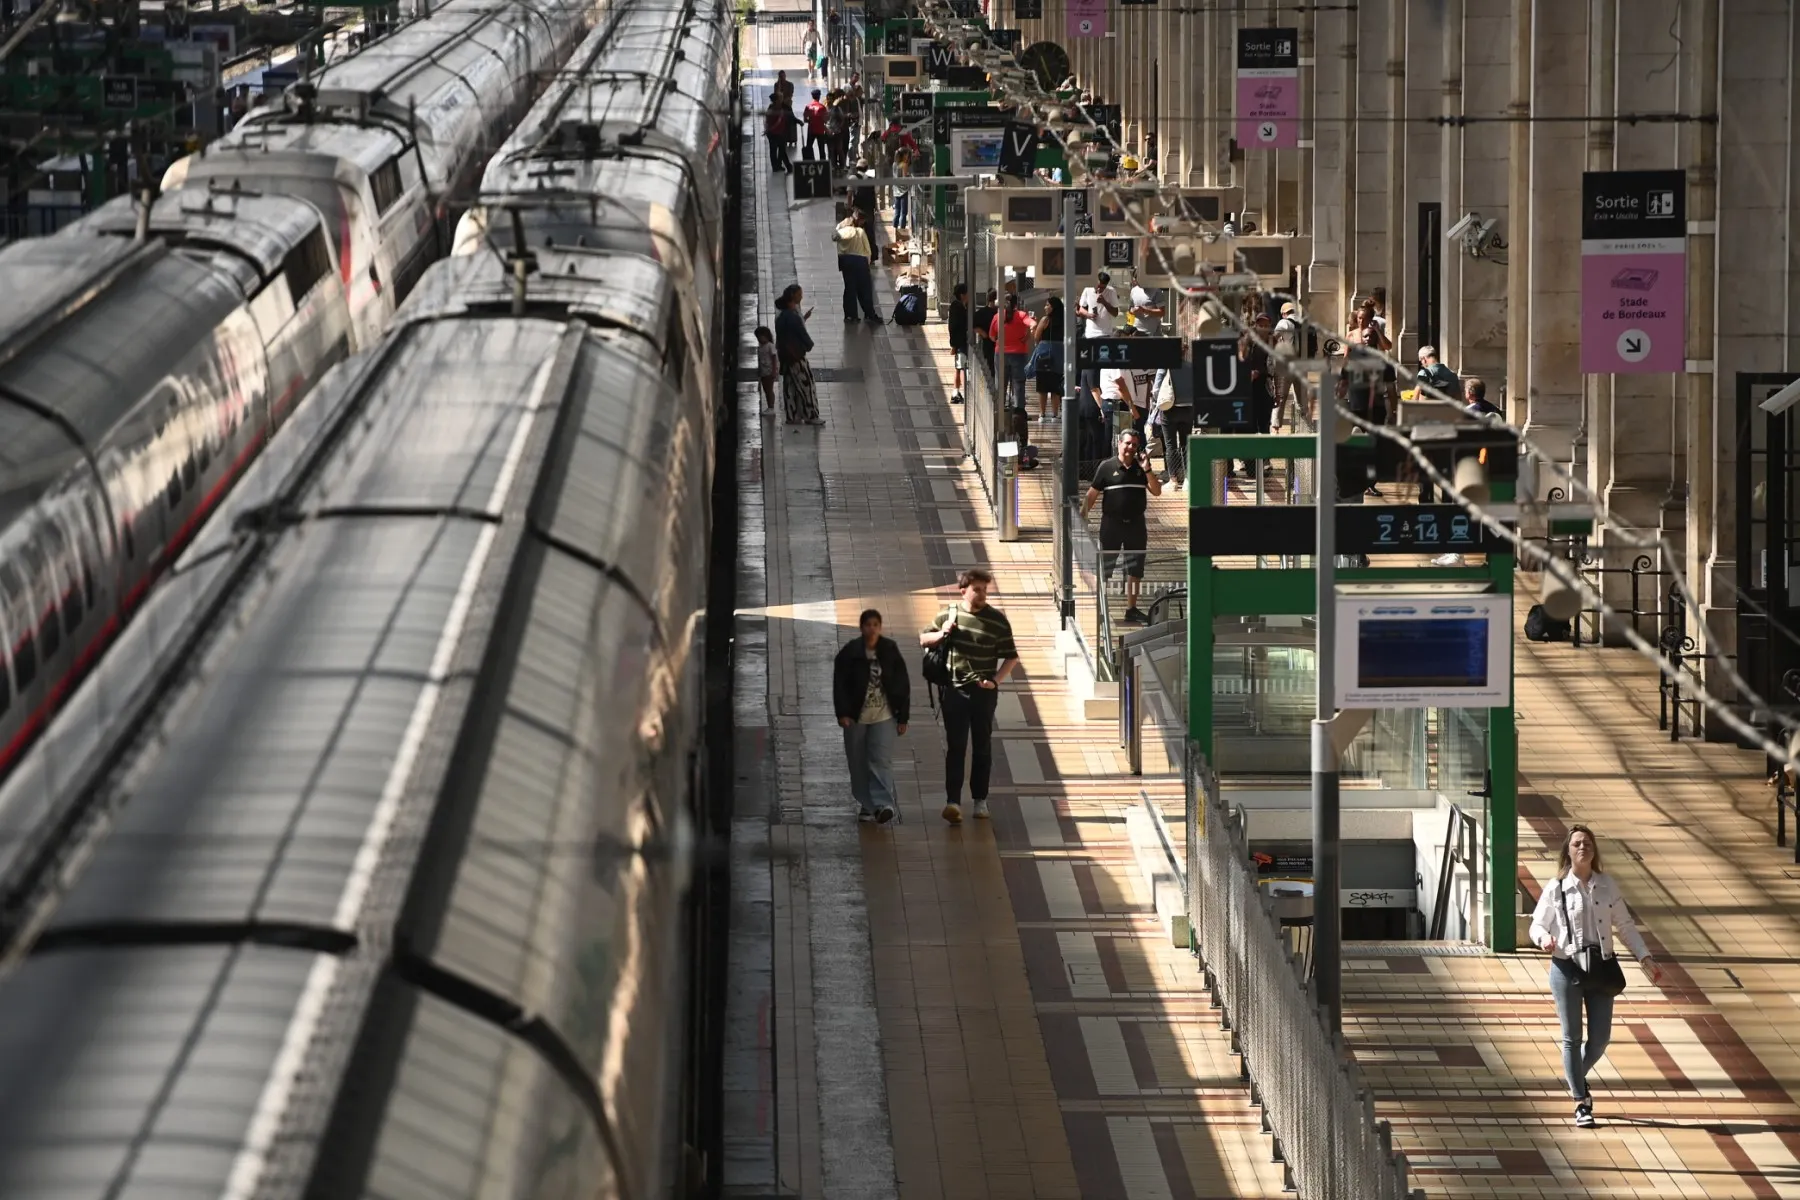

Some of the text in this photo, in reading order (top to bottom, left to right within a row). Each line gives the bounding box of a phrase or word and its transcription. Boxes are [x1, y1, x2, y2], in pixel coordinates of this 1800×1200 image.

[1245, 42, 1271, 50] Sortie
[932, 48, 952, 66] W
[1012, 131, 1032, 156] V
[800, 164, 823, 176] TGV
[807, 178, 815, 197] 1
[1595, 194, 1639, 208] Sortie
[1594, 212, 1608, 220] Exit
[1620, 297, 1648, 307] Stade
[1602, 310, 1667, 319] de Bordeaux
[1119, 350, 1126, 360] 1
[1205, 355, 1237, 395] U
[1234, 408, 1242, 421] 1
[1380, 523, 1392, 540] 2
[1415, 523, 1438, 540] 14
